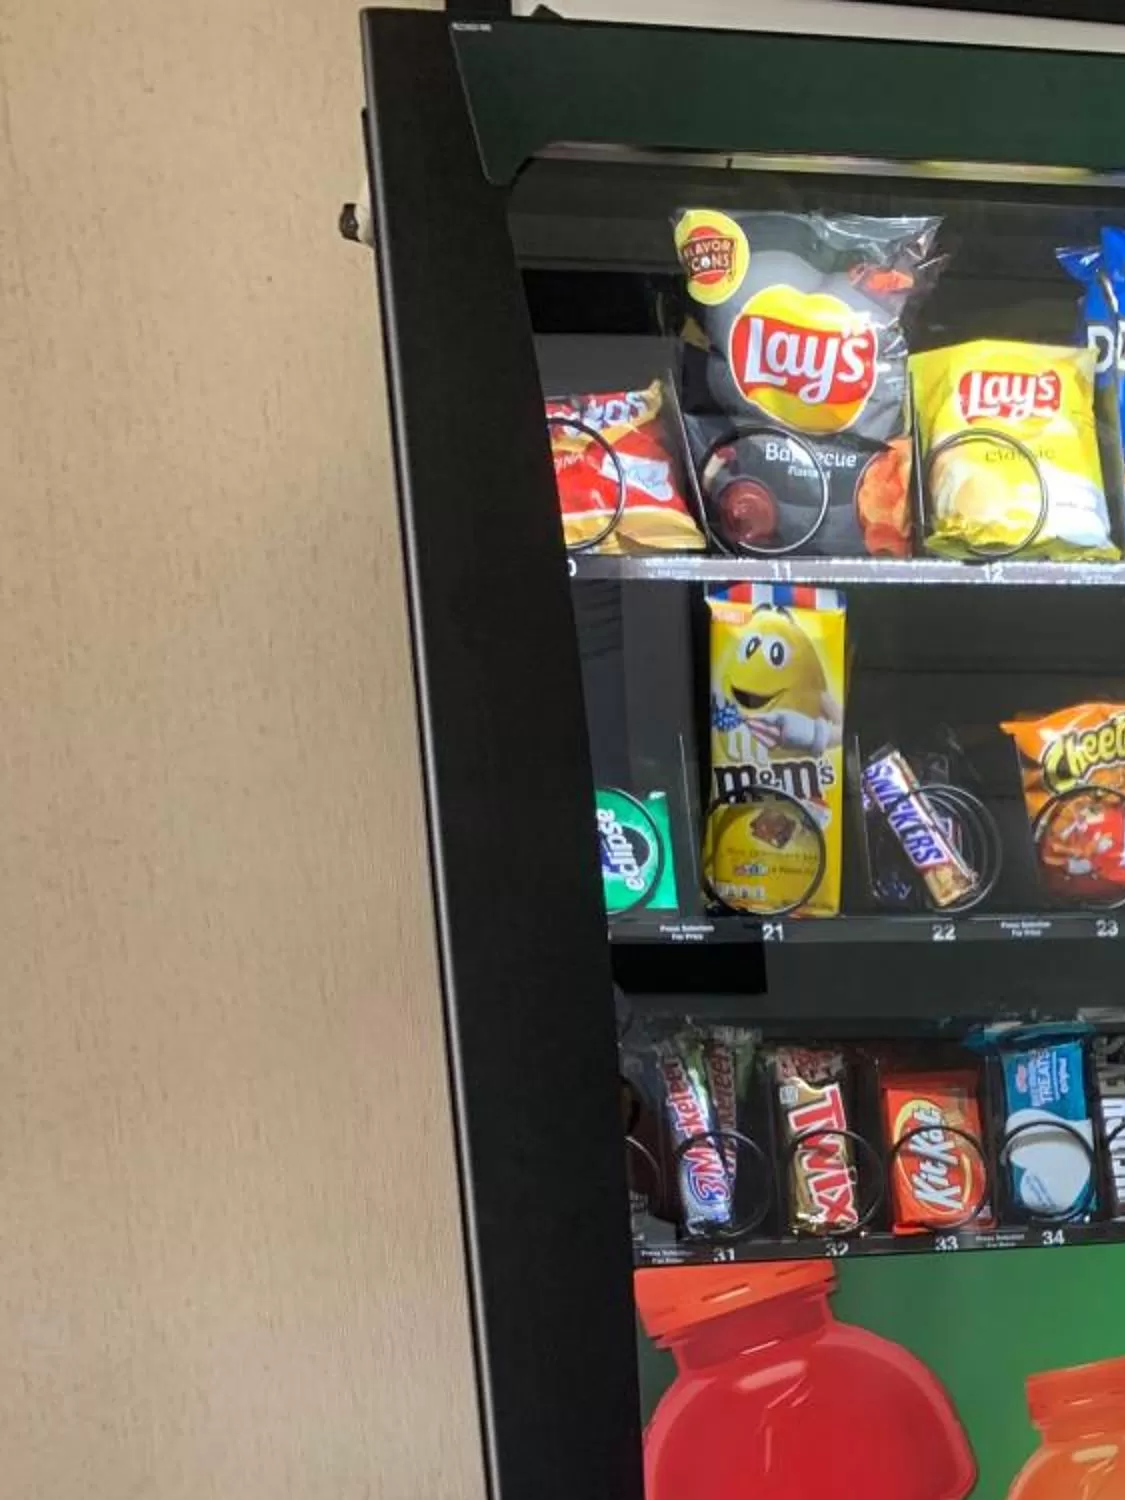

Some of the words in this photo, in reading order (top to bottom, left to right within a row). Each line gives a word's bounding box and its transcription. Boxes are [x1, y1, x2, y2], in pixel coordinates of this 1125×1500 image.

[743, 315, 871, 404] Lay's
[965, 370, 1056, 424] Lay's
[764, 441, 858, 469] Baecue
[864, 762, 945, 865] SNCKRS
[762, 923, 784, 941] 21
[932, 924, 956, 941] 22
[1096, 919, 1119, 937] 23
[935, 1235, 959, 1251] 33
[1042, 1229, 1066, 1246] 34
[712, 1247, 736, 1263] 31
[825, 1242, 849, 1258] 32
